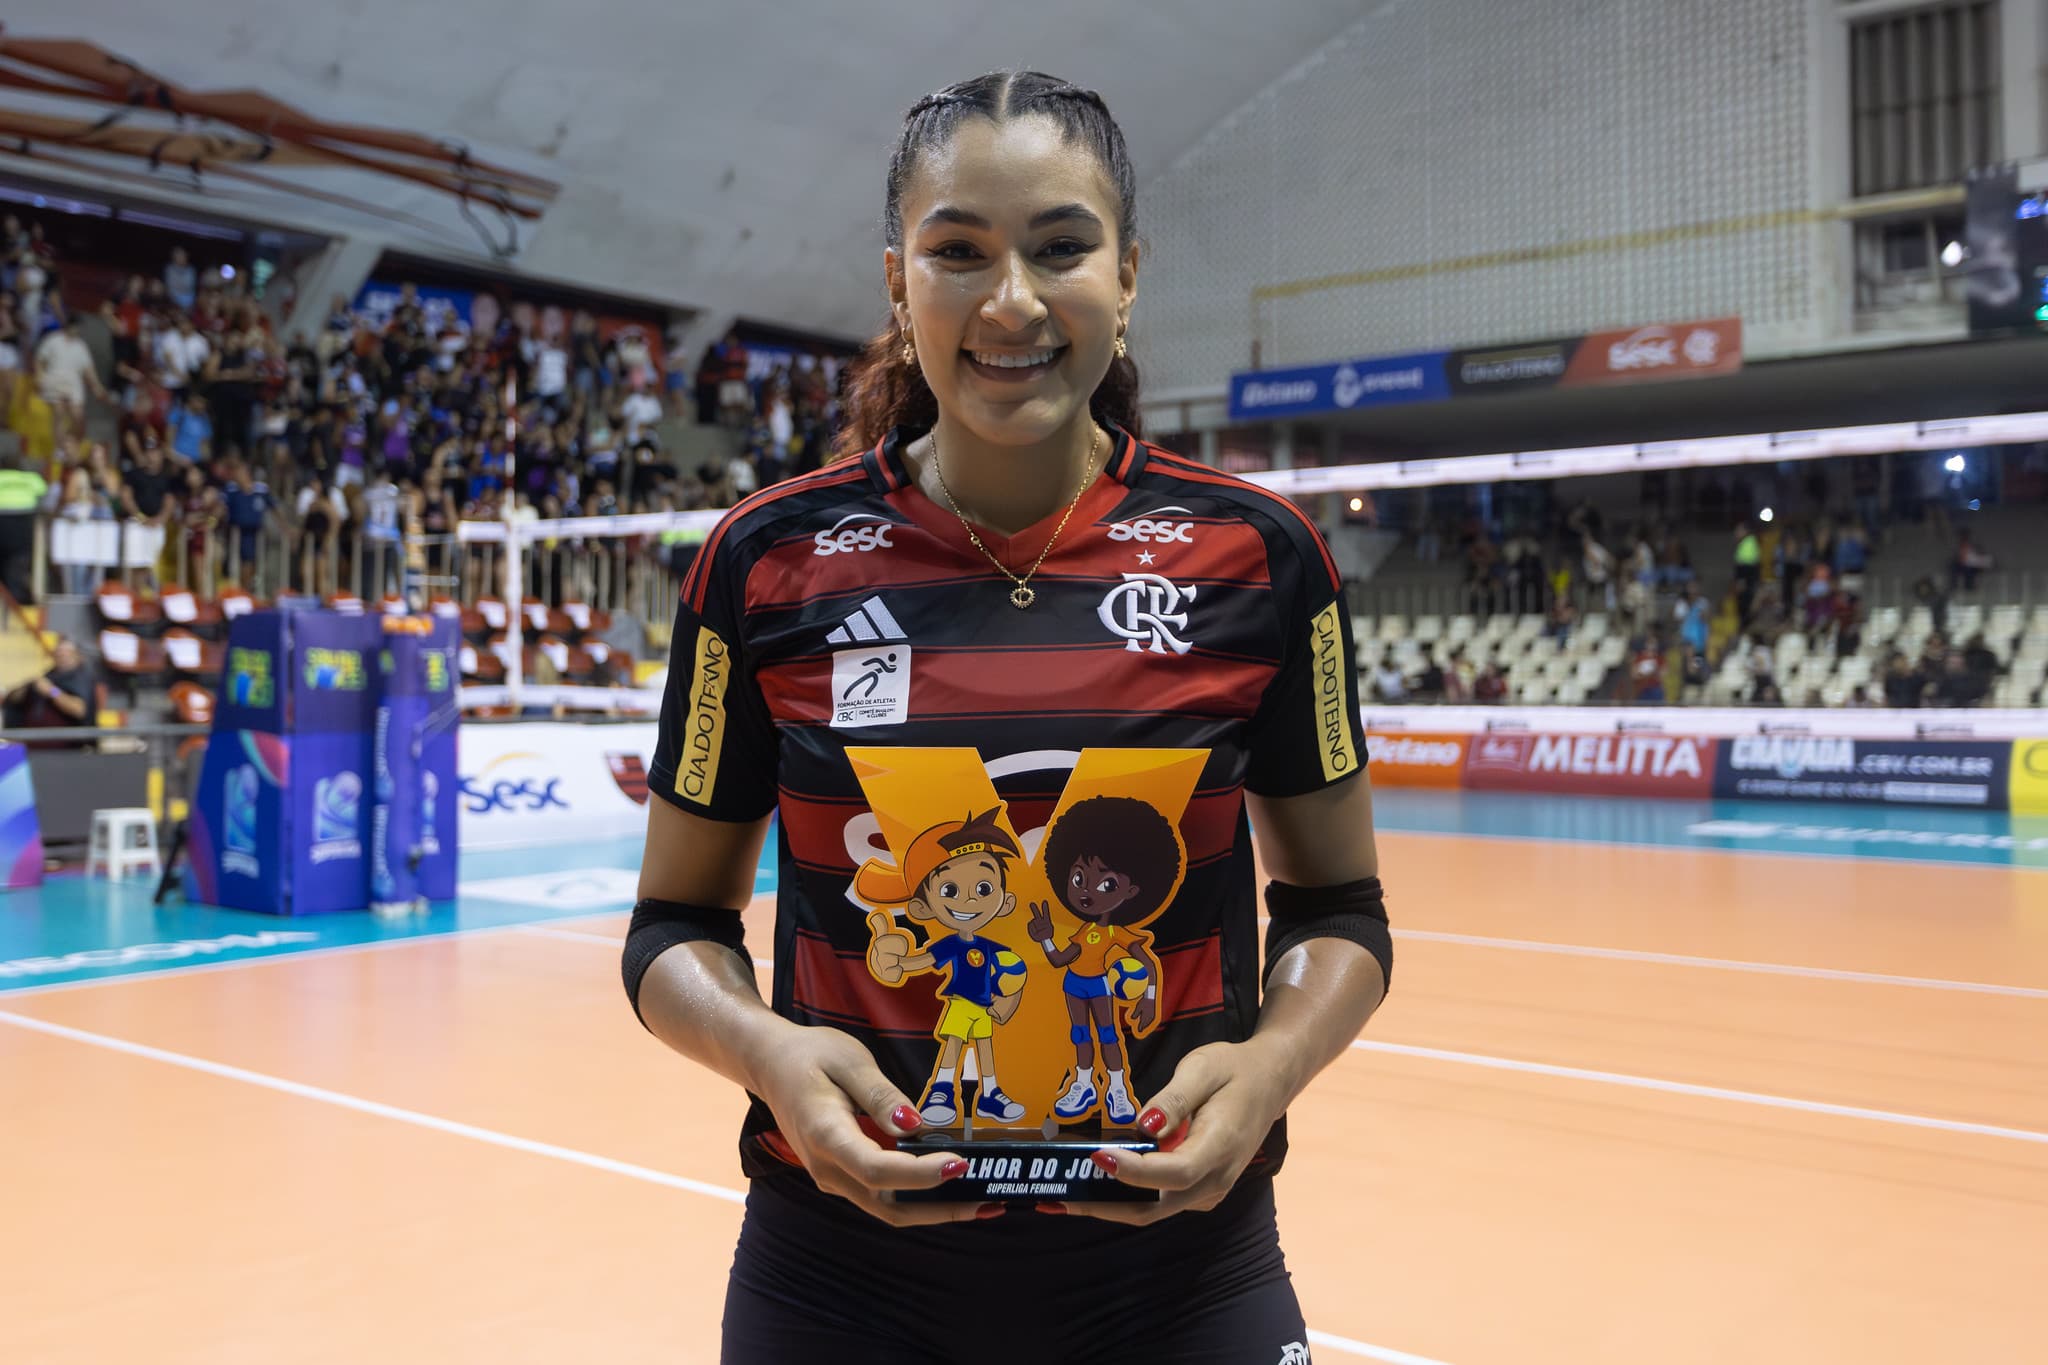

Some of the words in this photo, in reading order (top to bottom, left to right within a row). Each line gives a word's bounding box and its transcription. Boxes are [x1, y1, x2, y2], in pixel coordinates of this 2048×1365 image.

[837, 699, 864, 708] FORMAÇÃO
[837, 711, 854, 722] CBC
[1529, 736, 1702, 778] MELITTA
[958, 1157, 1022, 1179] LHOR
[1029, 1157, 1058, 1179] DO
[1065, 1157, 1115, 1180] JOG
[986, 1182, 1029, 1194] SUPERLIGA
[1029, 1182, 1067, 1194] FEMININA
